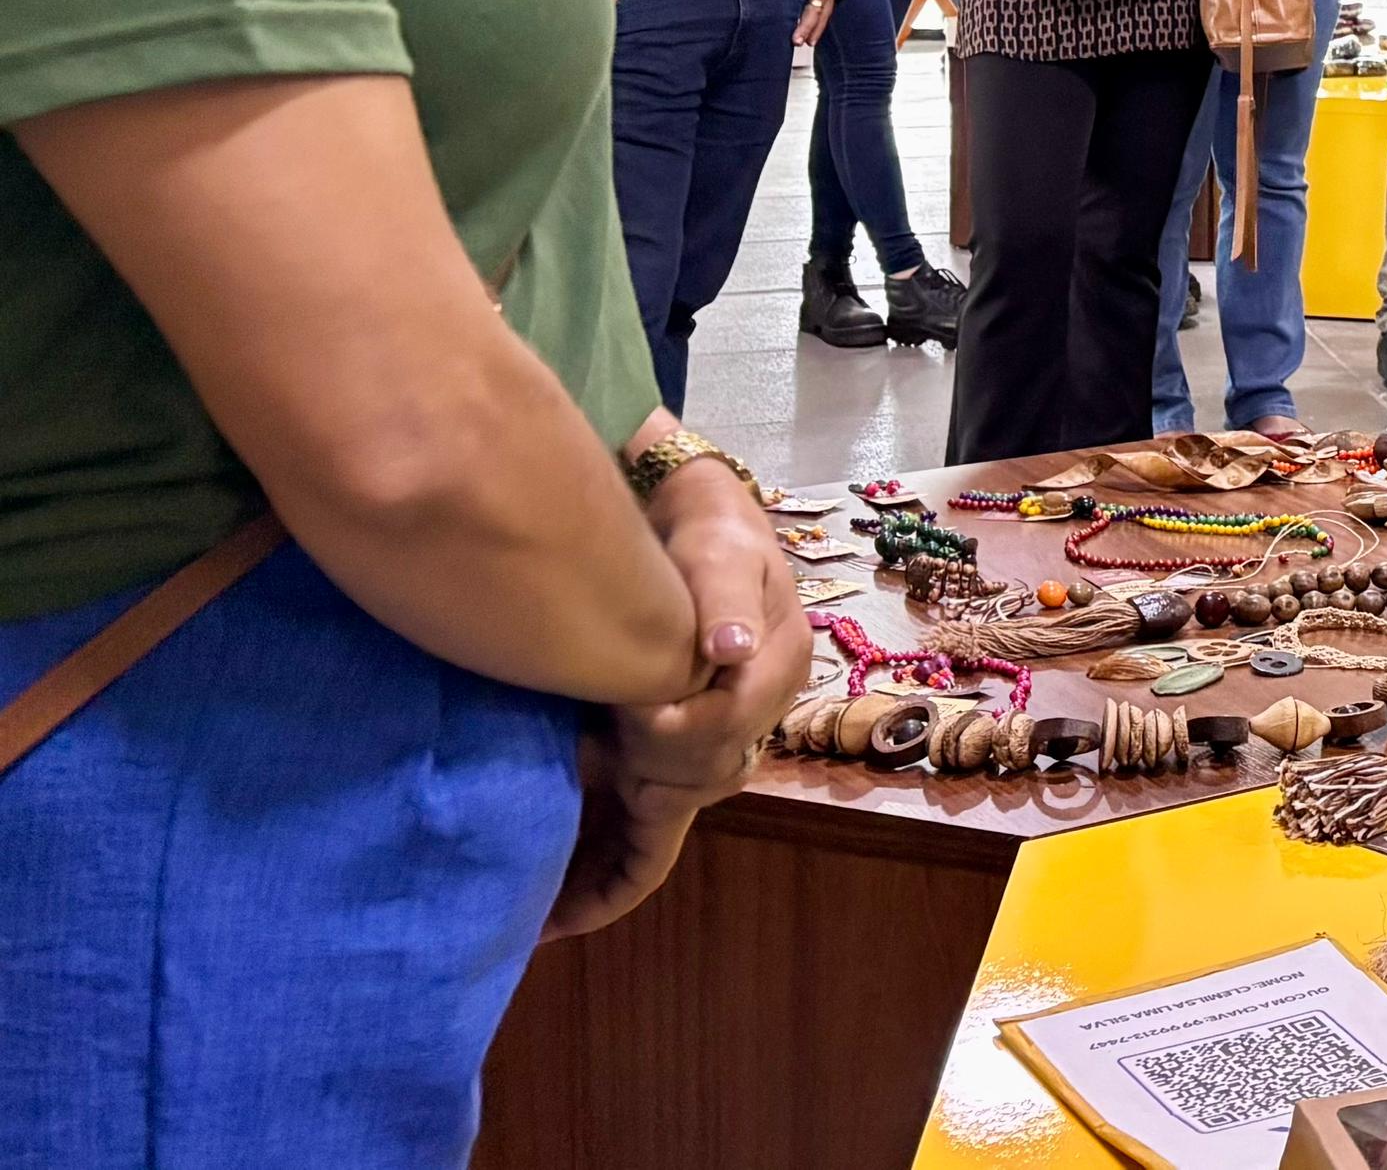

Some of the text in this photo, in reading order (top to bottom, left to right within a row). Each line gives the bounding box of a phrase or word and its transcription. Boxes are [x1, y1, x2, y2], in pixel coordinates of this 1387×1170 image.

[1251, 970, 1305, 989] NOME:
[1271, 992, 1307, 1007] COM
[1307, 986, 1330, 997] OU
[1257, 1001, 1270, 1009] A
[1204, 1005, 1259, 1022] CHAVE:
[1079, 1014, 1131, 1031] SILVA
